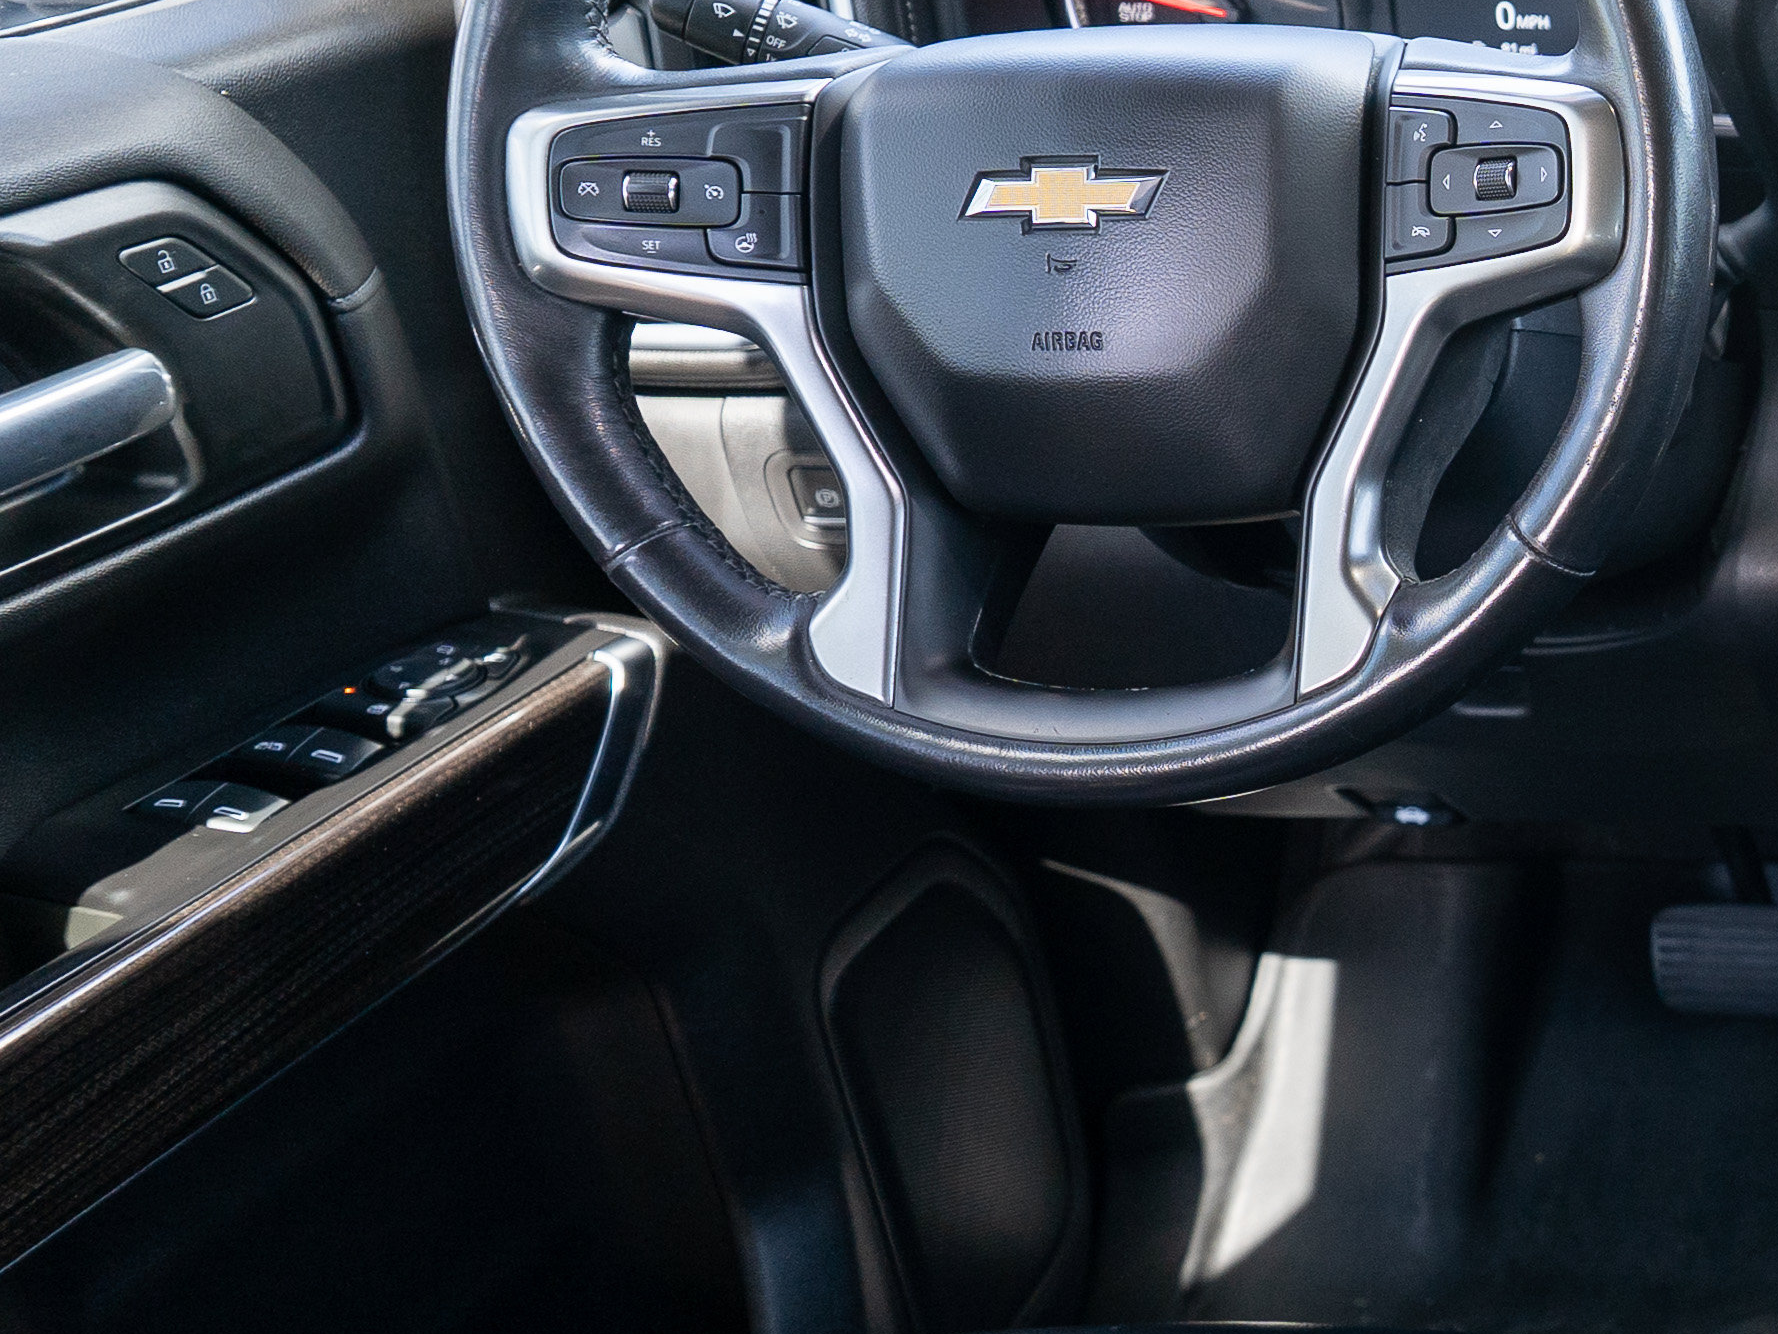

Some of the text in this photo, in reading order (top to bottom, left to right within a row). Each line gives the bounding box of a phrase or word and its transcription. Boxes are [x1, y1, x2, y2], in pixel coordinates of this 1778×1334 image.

[1118, 1, 1152, 13] AUTO
[1118, 11, 1153, 23] STOP
[1494, 0, 1552, 31] 0 MPH
[765, 34, 788, 49] OFF
[640, 136, 662, 147] RES
[642, 240, 661, 251] SET
[1031, 330, 1104, 352] AIRBAG
